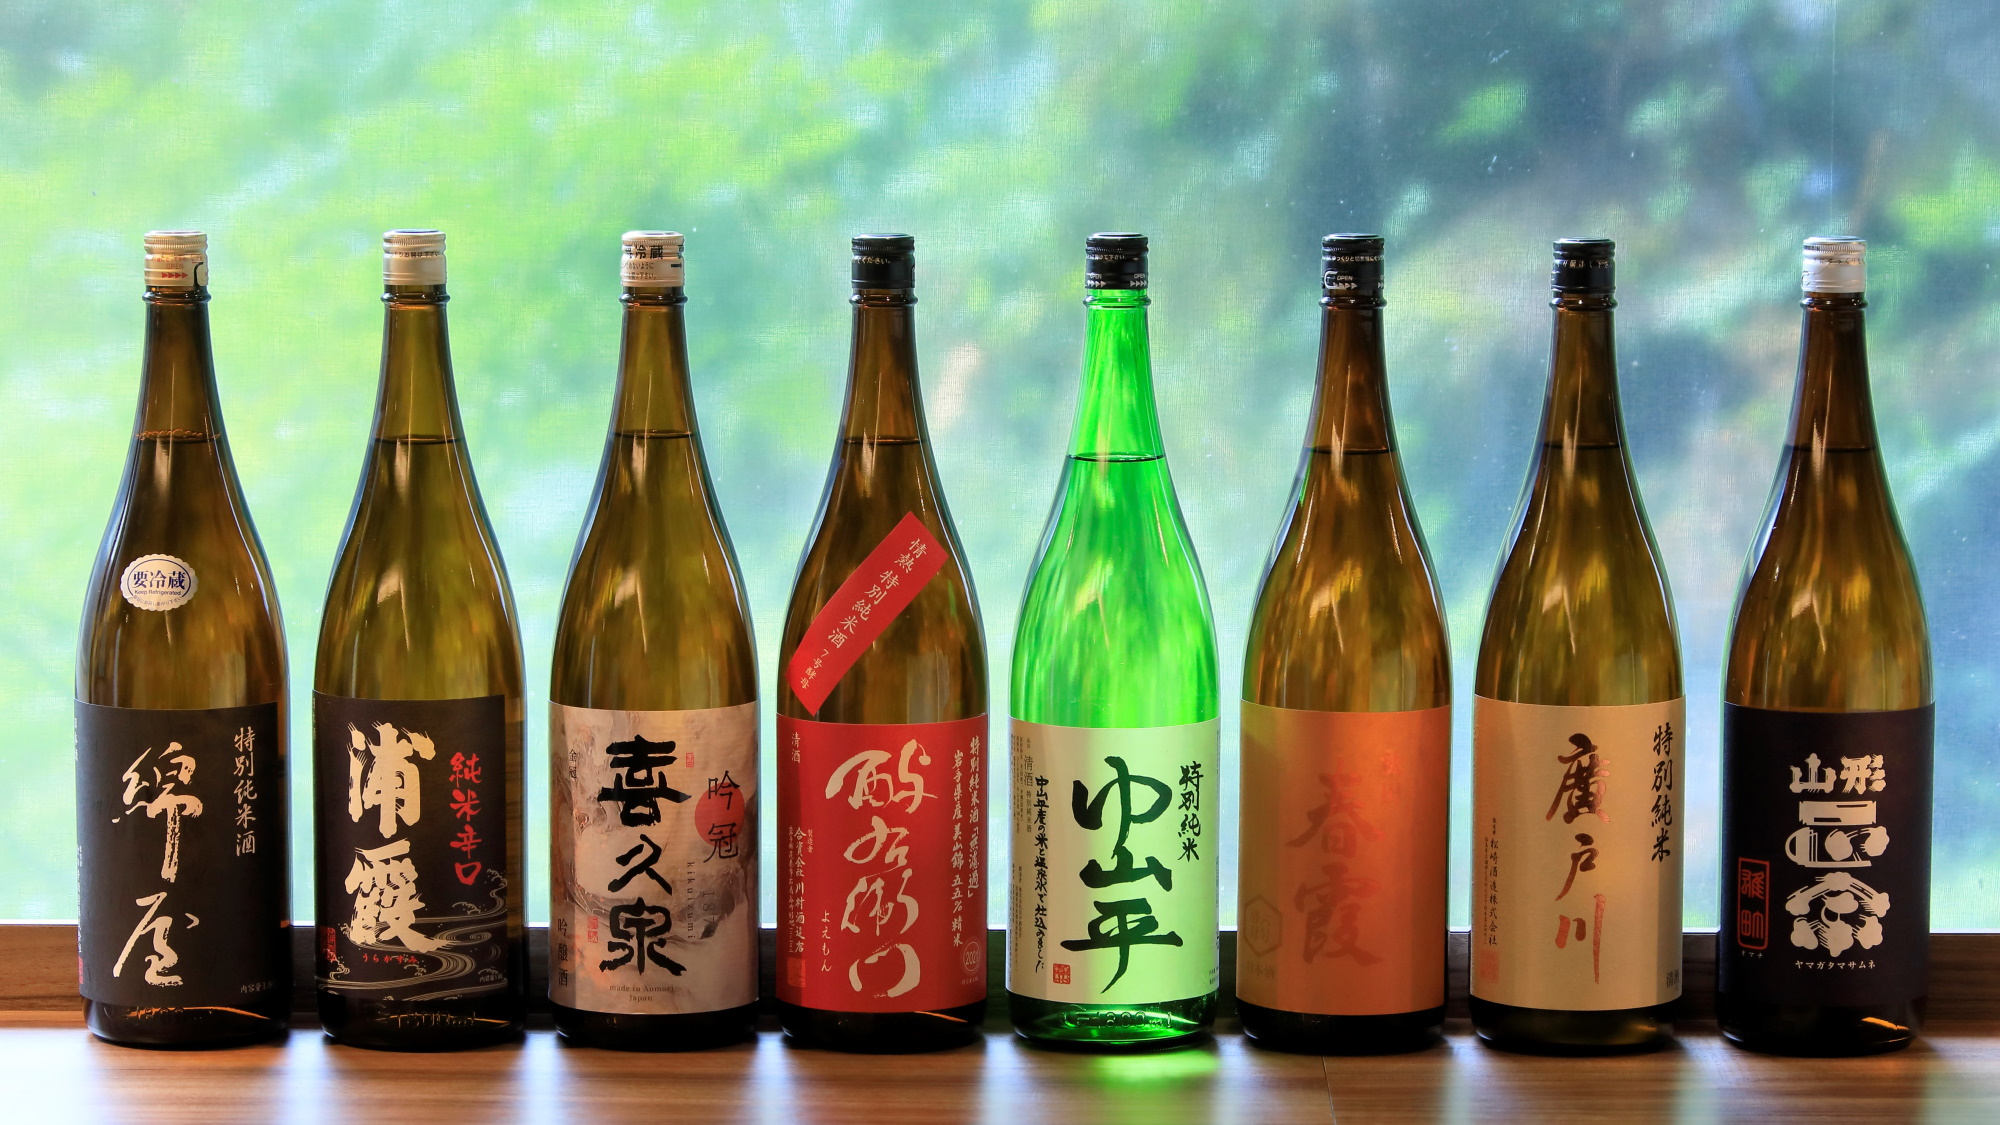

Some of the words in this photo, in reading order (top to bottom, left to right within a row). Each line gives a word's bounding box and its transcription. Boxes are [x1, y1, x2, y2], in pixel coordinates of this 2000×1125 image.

[132, 570, 186, 590] 要冷蔵
[827, 570, 900, 649] 特別純米酒
[791, 732, 801, 763] 清酒
[1023, 755, 1034, 787] 清酒
[233, 726, 258, 857] 特別純米酒
[449, 752, 482, 886] 純米辛口
[702, 770, 741, 864] 吟冠
[1177, 760, 1204, 863] 特別純米
[1650, 722, 1674, 864] 特別純米
[111, 741, 203, 987] 綿屋
[344, 720, 453, 953] 浦霞
[596, 734, 692, 977] 喜久泉
[1284, 755, 1387, 967] 春霞
[687, 861, 696, 939] kikuizumi
[362, 952, 418, 965] うらがすみ
[557, 917, 569, 989] 吟醸酒
[821, 908, 832, 973] よえもん
[1794, 960, 1877, 970] ヤマガタマサムネ
[609, 984, 630, 992] made
[632, 984, 641, 992] in
[644, 984, 674, 993] Aomori
[629, 994, 653, 1003] Japan
